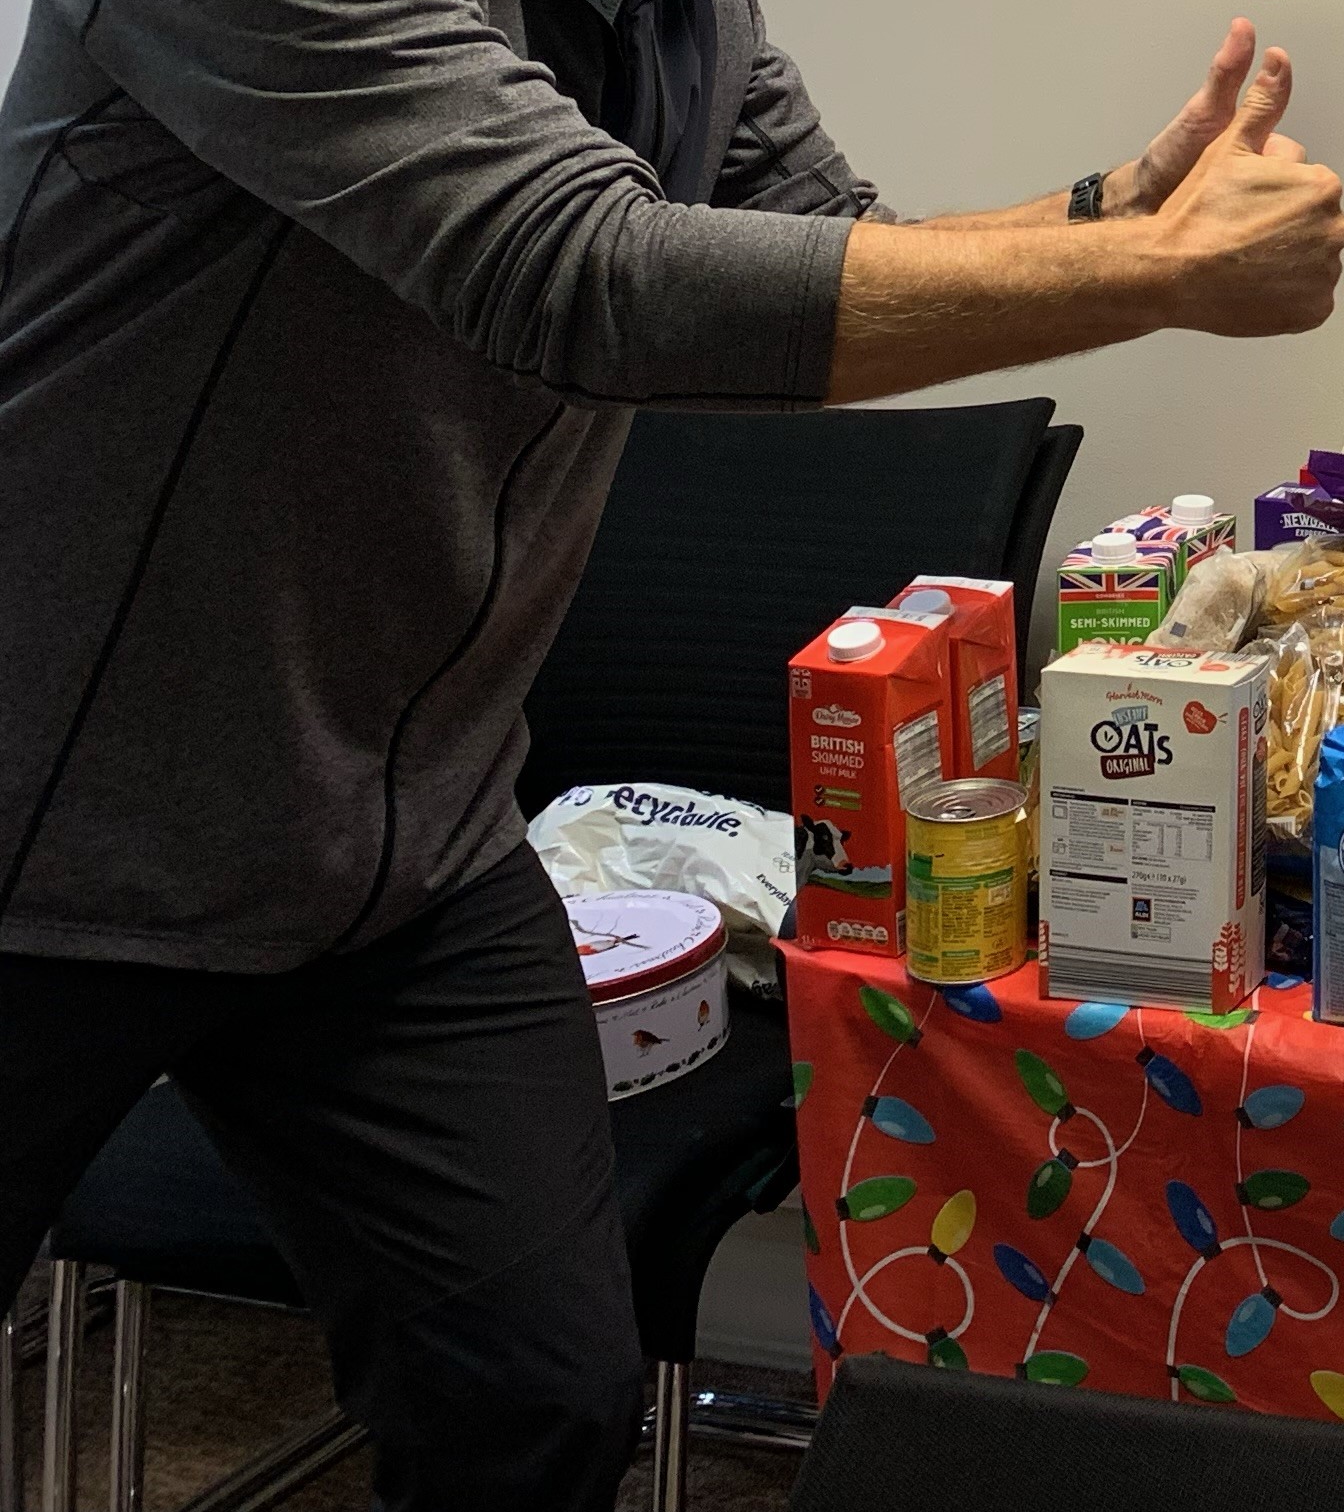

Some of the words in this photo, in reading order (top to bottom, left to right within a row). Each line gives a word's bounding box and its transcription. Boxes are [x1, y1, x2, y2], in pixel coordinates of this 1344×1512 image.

[1070, 617, 1150, 629] SEMI-SKIMMED
[810, 735, 864, 754] BRITISH
[812, 751, 864, 768] SKIMMED
[1106, 756, 1150, 774] ORIGINAL
[756, 873, 792, 906] Everyday
